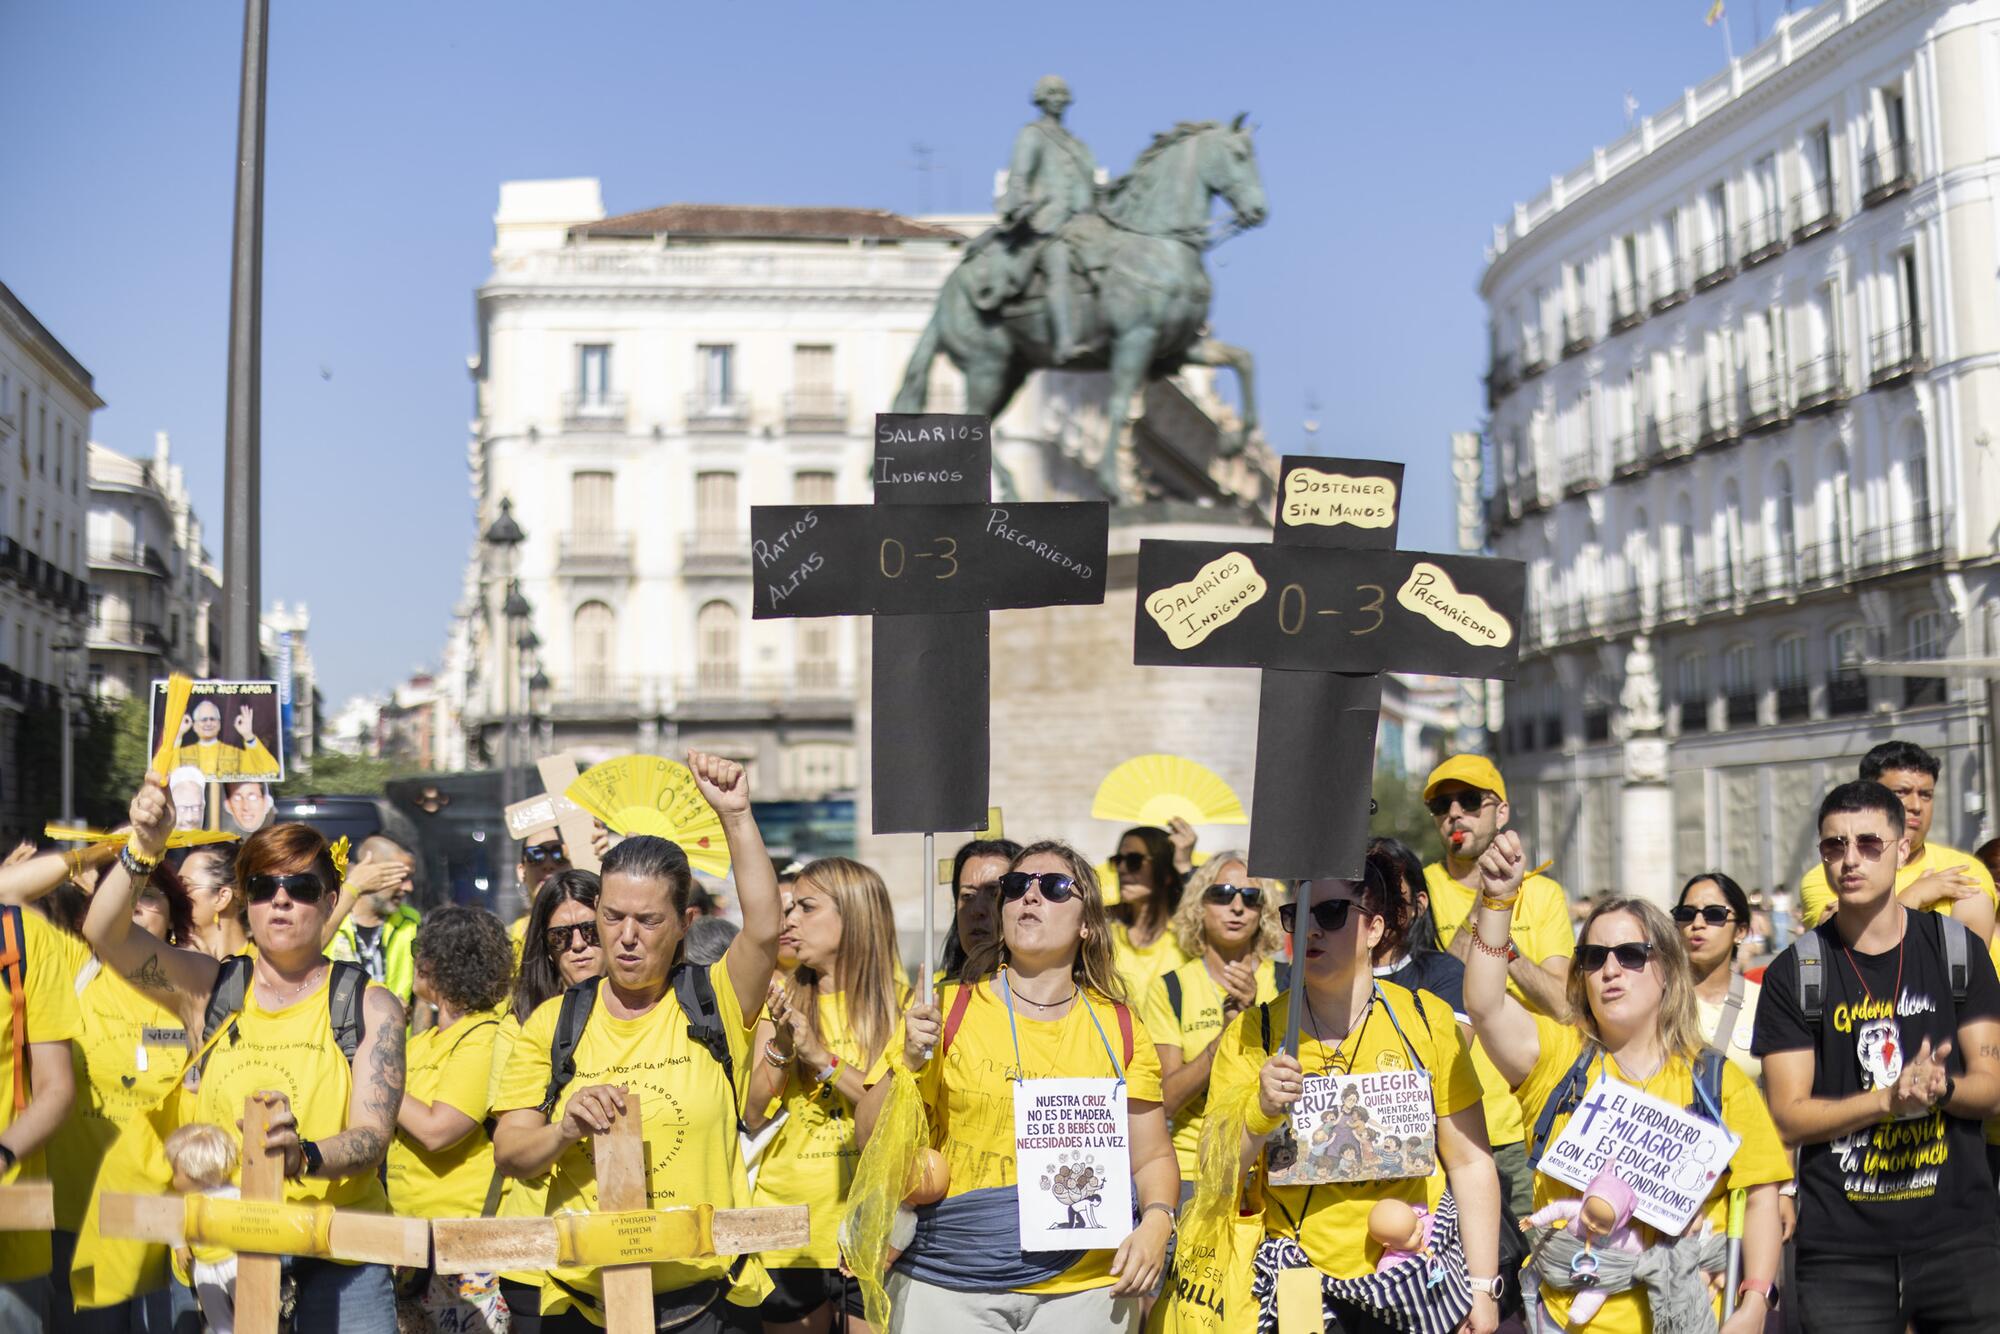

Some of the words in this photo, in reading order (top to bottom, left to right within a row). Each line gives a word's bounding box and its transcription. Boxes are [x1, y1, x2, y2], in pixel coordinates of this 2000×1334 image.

[879, 424, 984, 443] SALARIOS
[876, 457, 963, 483] INDIGNOS
[1293, 472, 1385, 494] SOSTENER
[1329, 503, 1385, 518] MANOS
[754, 510, 818, 568] RATIOS
[986, 508, 1093, 579] PRECARIEDAD
[880, 537, 958, 579] 0-3
[767, 552, 825, 610] ALTAS
[1154, 561, 1240, 621] SALARIOS
[1406, 572, 1497, 640] PRECARIEDAD
[613, 1066, 630, 1074] VOZ
[644, 1062, 656, 1070] LA
[1303, 1078, 1338, 1094] ESTRA
[1361, 1073, 1419, 1094] ELEGIR
[644, 1082, 686, 1122] LABORAL
[1036, 1096, 1080, 1107] NUESTRA
[1082, 1095, 1106, 1107] CRUZ
[1364, 1092, 1392, 1108] QUIÉN
[1396, 1090, 1430, 1104] ESPERA
[1028, 1110, 1042, 1121] NO
[1045, 1109, 1058, 1120] ES
[1060, 1109, 1073, 1120] DE
[1074, 1109, 1115, 1121] MADERA,
[1377, 1104, 1419, 1115] MIENTRAS
[1381, 1112, 1430, 1125] ATENDEMOS
[1027, 1124, 1040, 1135] ES
[1042, 1123, 1055, 1135] DE
[1058, 1122, 1065, 1135] 8
[1068, 1121, 1095, 1134] BEBÉS
[1097, 1122, 1116, 1134] CON
[1297, 1117, 1311, 1129] ES
[1394, 1123, 1401, 1134] A
[1403, 1122, 1427, 1134] OTRO
[1611, 1094, 1628, 1114] EL
[1630, 1102, 1701, 1145] VERDADERO
[1017, 1136, 1083, 1149] NECESIDADES
[1084, 1137, 1092, 1148] A
[1093, 1137, 1105, 1148] LA
[1107, 1136, 1126, 1148] VEZ.
[1607, 1117, 1683, 1162] MILAGRO
[1595, 1135, 1618, 1155] ES
[1616, 1145, 1671, 1180] EDUCAR
[1840, 1149, 1859, 1173] la
[1556, 1140, 1584, 1162] CON
[1582, 1152, 1622, 1177] ESTS
[1621, 1170, 1696, 1214] CONDICIONES
[1566, 1165, 1581, 1176] ALTAS
[1844, 1176, 1862, 1192] 0-3
[1863, 1178, 1878, 1193] ES
[1879, 1170, 1938, 1193] EDUCACIÓN
[646, 1190, 676, 1200] ACIÓN
[629, 1237, 640, 1245] DE
[1192, 1246, 1217, 1260] VIDA
[1203, 1266, 1224, 1286] SER
